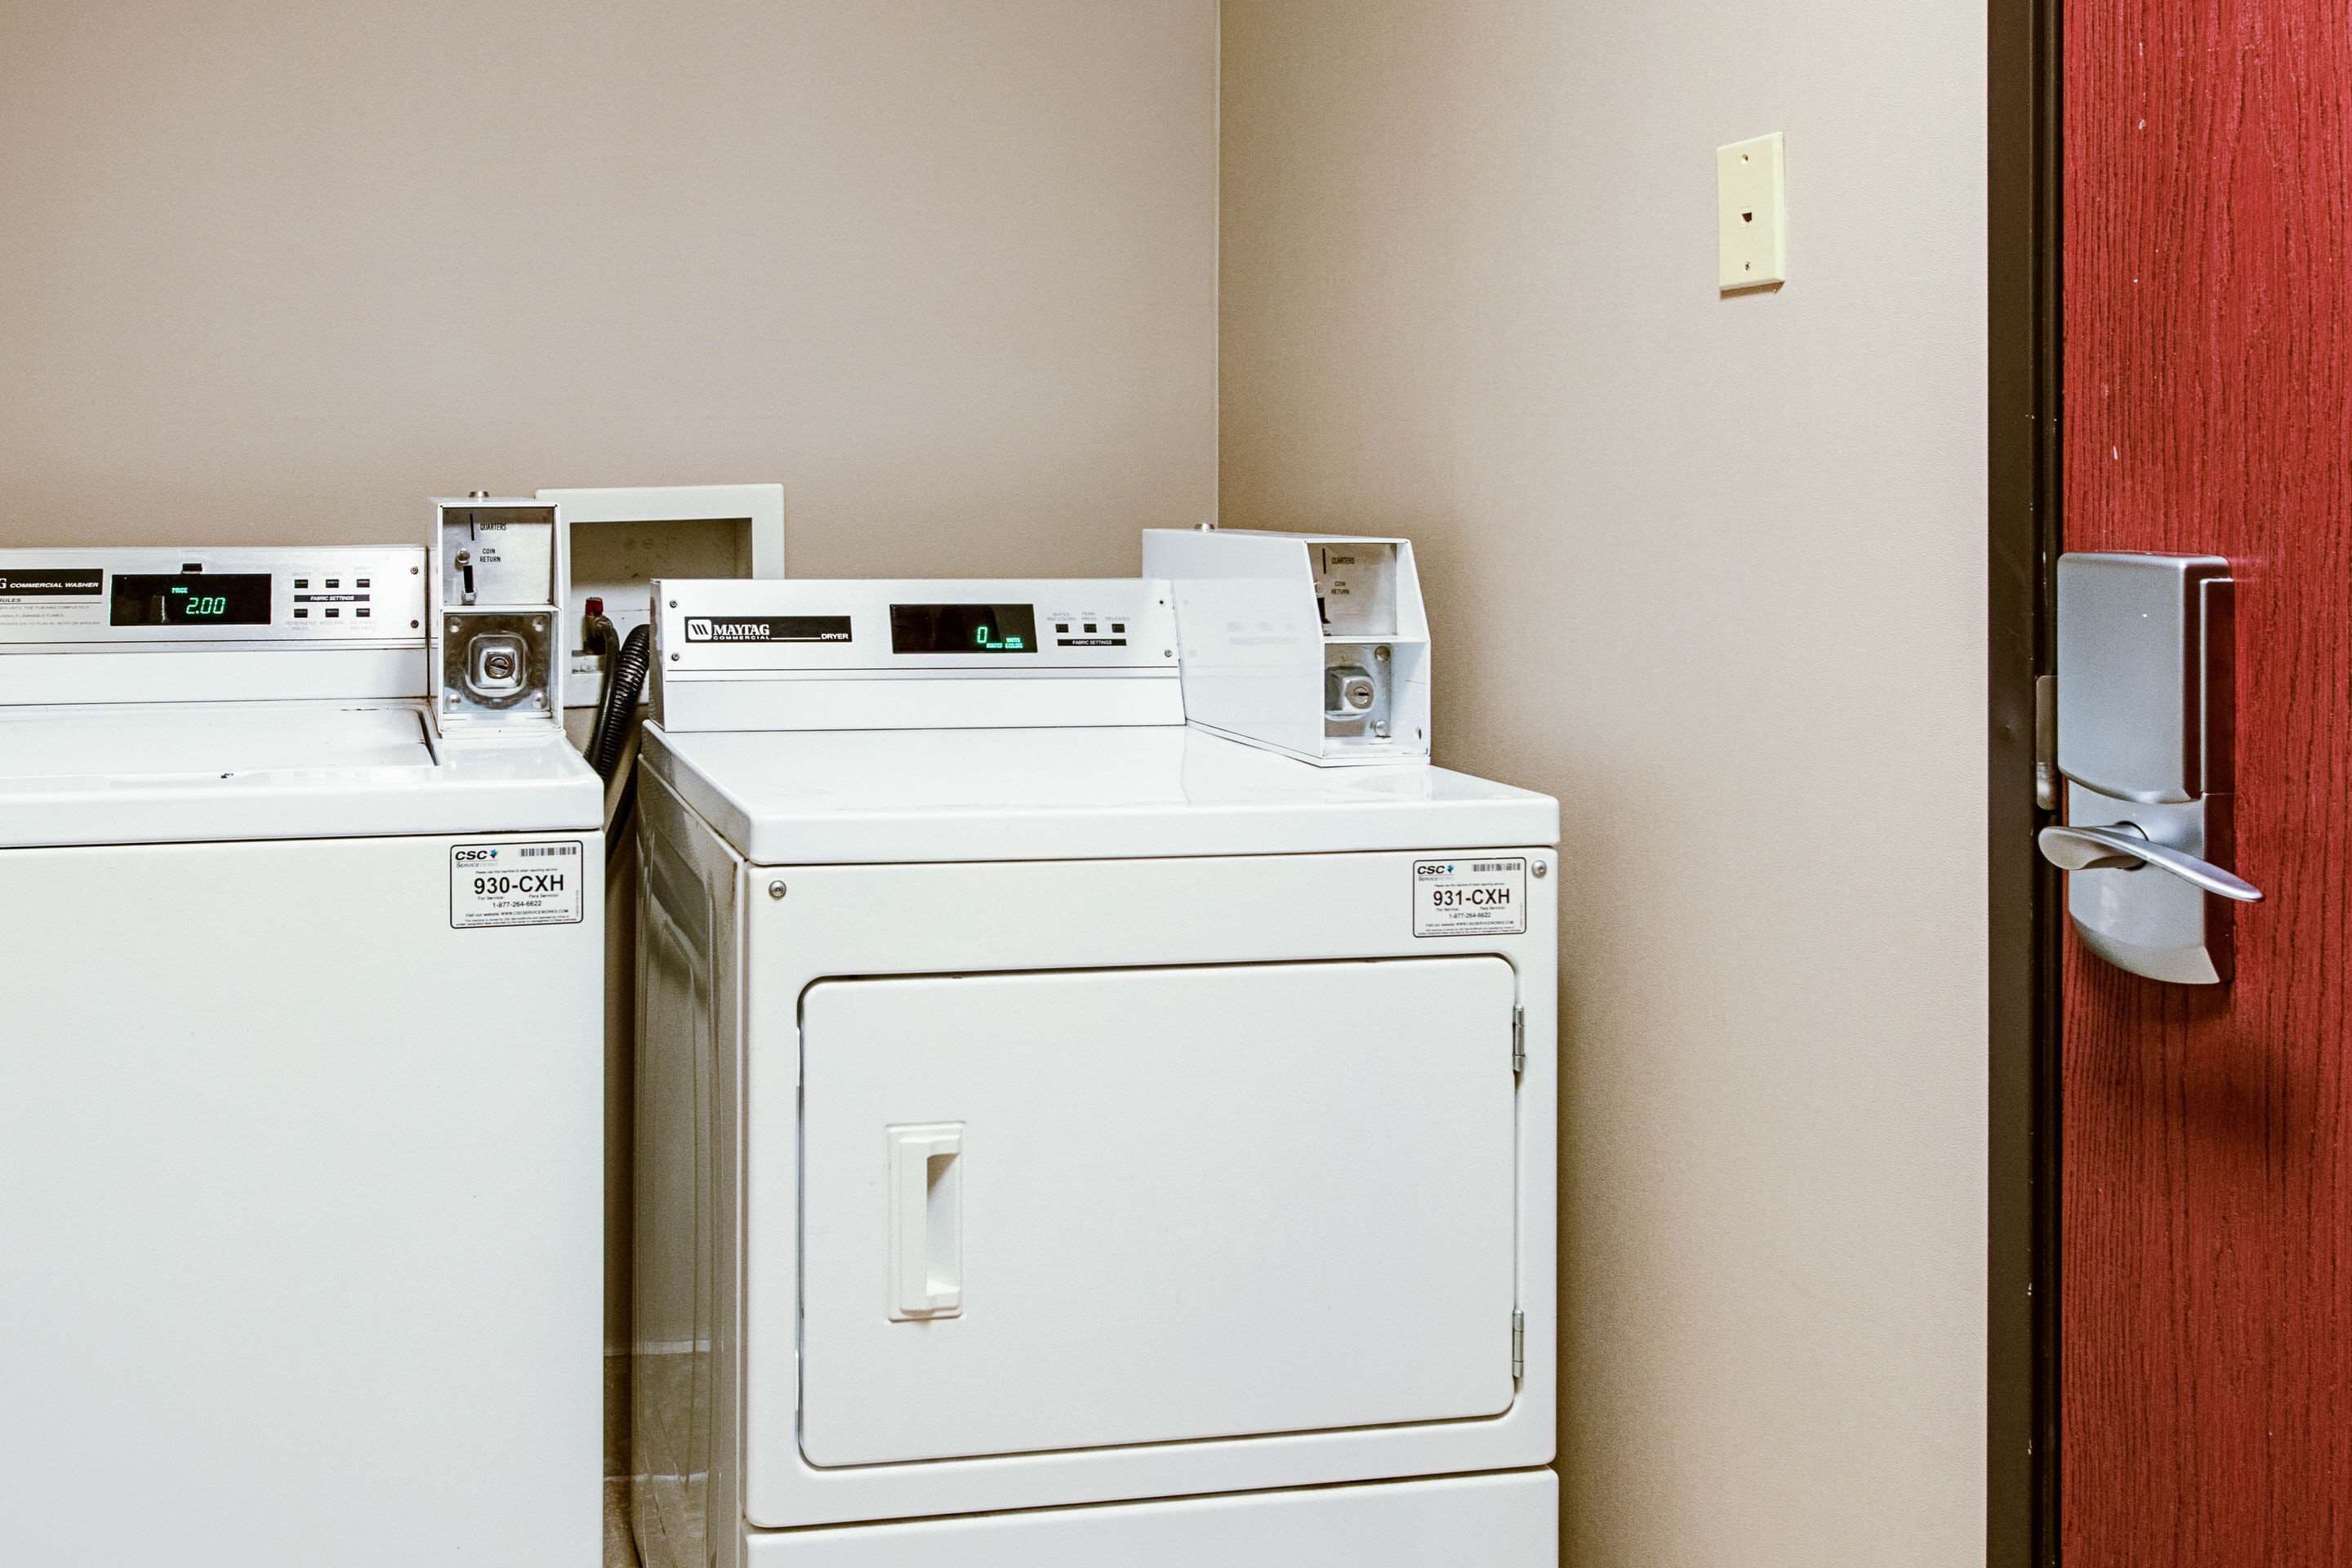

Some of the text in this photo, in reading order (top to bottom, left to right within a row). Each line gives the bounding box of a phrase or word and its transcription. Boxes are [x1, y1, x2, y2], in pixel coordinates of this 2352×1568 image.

[479, 523, 507, 531] QUARTERS
[186, 597, 226, 614] 2.00
[712, 624, 769, 635] MAYTAG
[977, 626, 988, 644] 0
[455, 850, 488, 861] CSC
[1417, 865, 1446, 875] CSC
[474, 874, 564, 895] 930-CXH
[1432, 888, 1511, 906] 931-CXH
